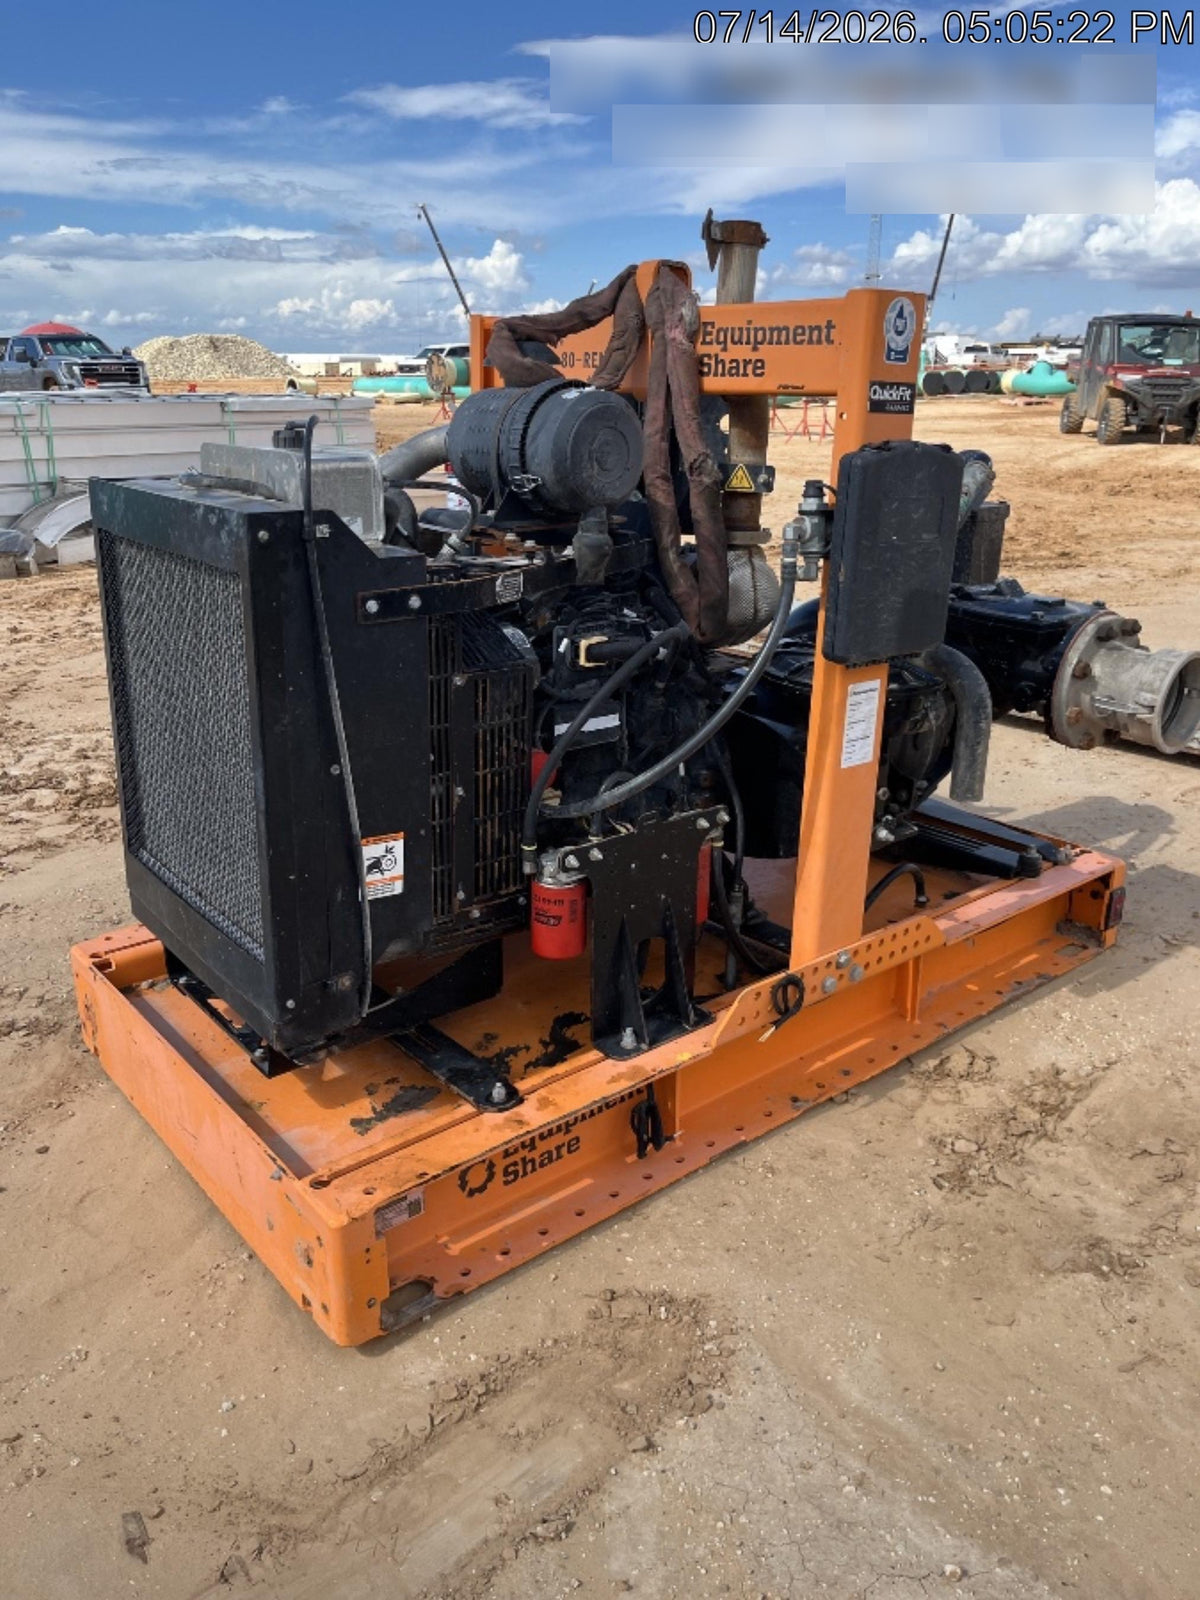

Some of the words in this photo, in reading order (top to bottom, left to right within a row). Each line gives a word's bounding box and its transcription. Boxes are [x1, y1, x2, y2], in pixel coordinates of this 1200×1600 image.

[700, 320, 836, 352] Equipment
[561, 351, 604, 369] 80-RE
[698, 353, 766, 378] Share
[870, 385, 912, 401] QuickFit
[502, 1135, 581, 1186] Share
